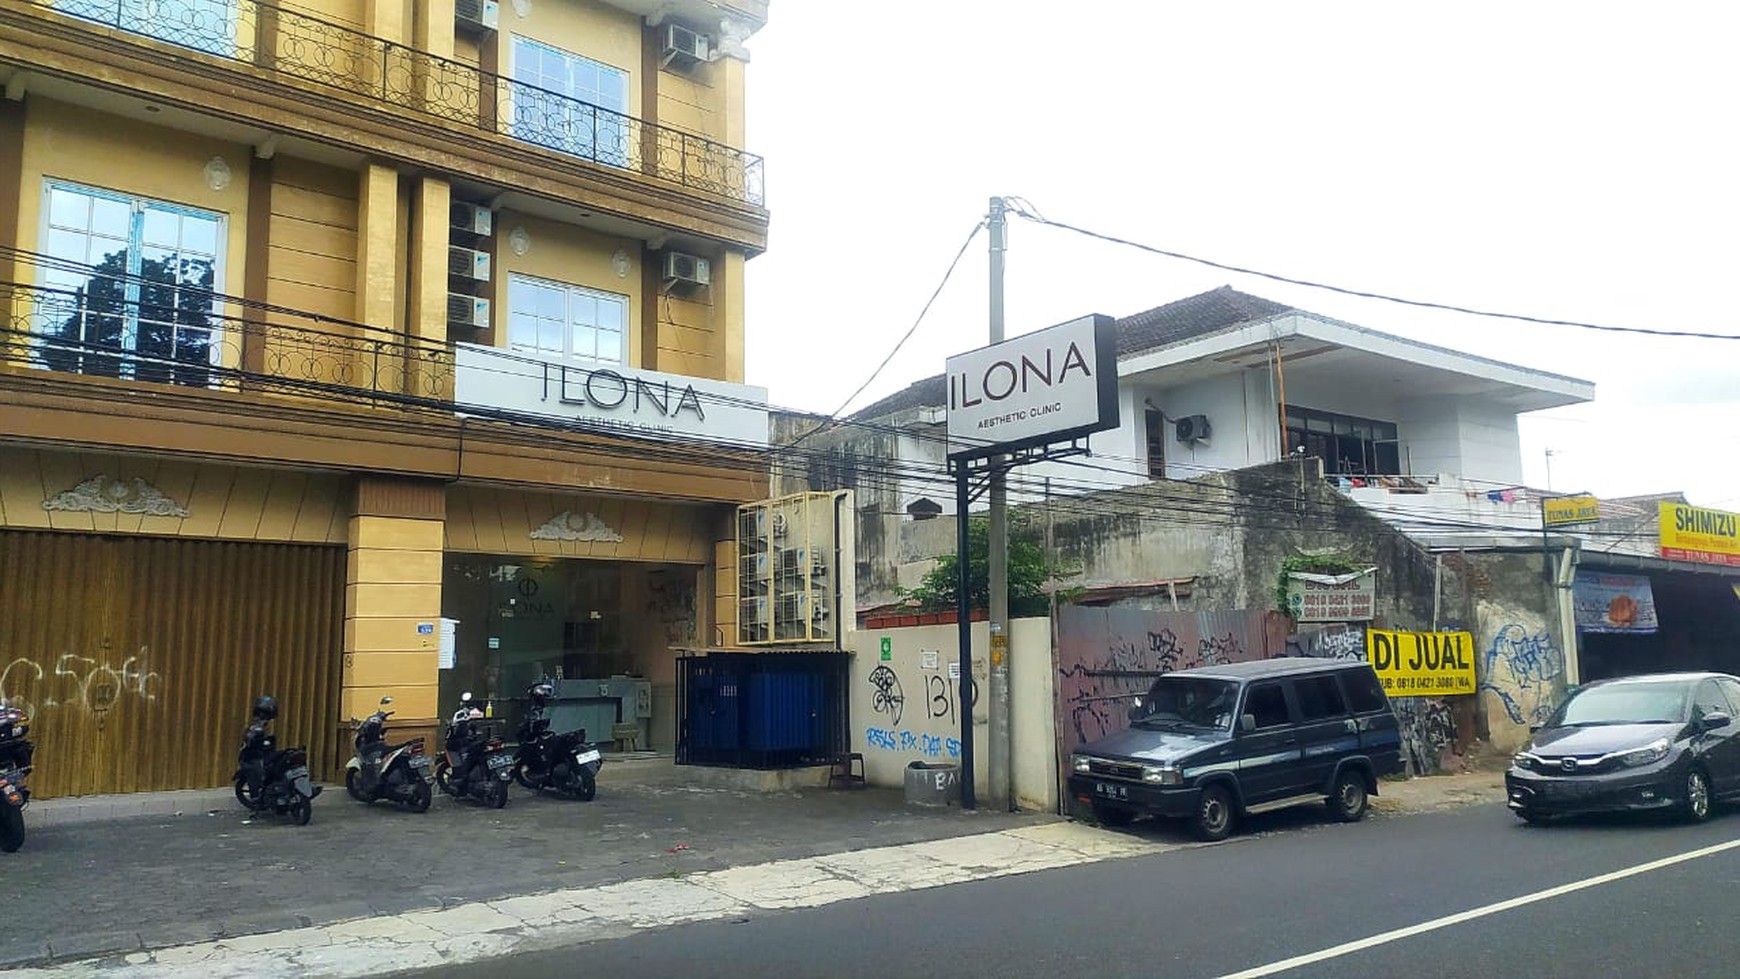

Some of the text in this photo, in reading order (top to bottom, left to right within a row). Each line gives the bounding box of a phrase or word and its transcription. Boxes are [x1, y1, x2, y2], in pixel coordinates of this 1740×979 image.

[951, 341, 1091, 411] ILONA
[541, 362, 706, 423] ILONA
[575, 414, 674, 434] AESTHETIC CLINIC
[977, 402, 1062, 430] AESTHETIC CLINIC
[1675, 507, 1736, 537] SHIMIZU
[1373, 633, 1400, 671] DI
[1409, 634, 1469, 671] JUAL
[1380, 677, 1395, 689] UB:
[1397, 677, 1416, 689] 0818
